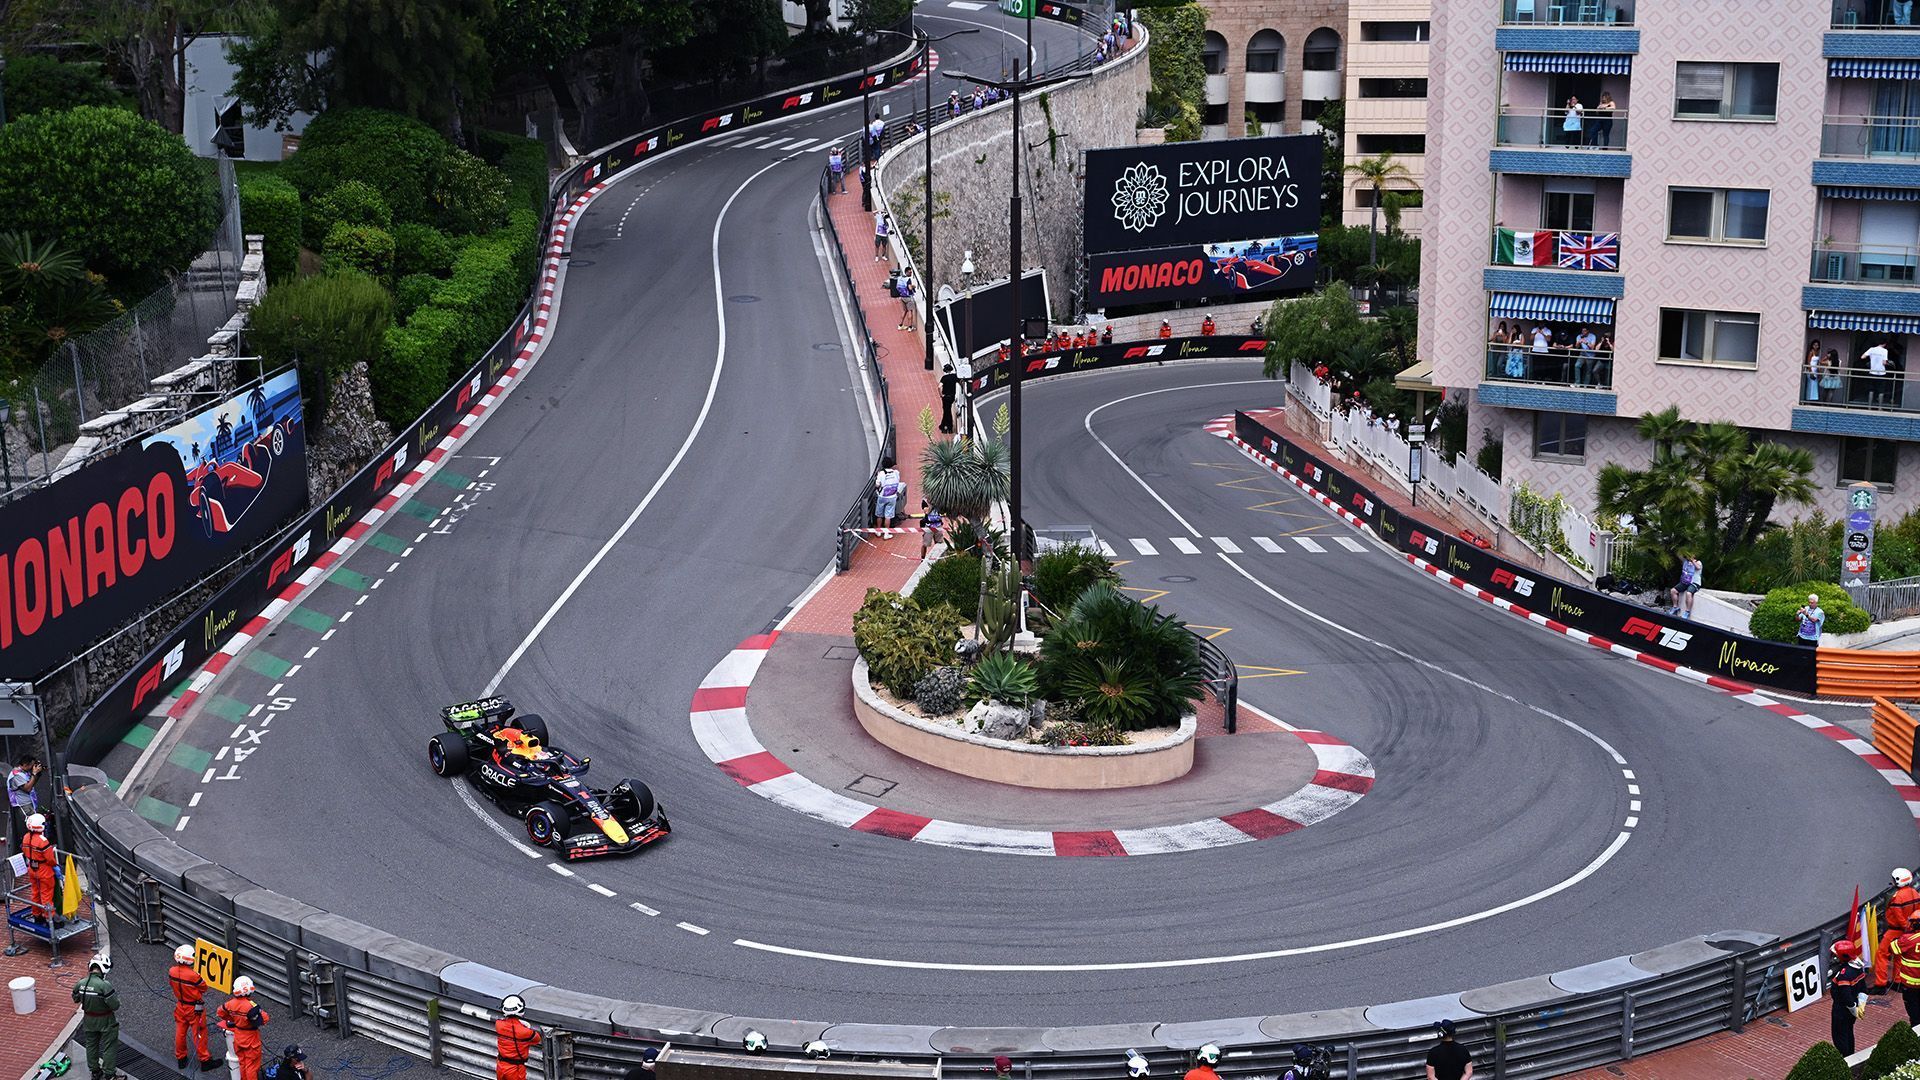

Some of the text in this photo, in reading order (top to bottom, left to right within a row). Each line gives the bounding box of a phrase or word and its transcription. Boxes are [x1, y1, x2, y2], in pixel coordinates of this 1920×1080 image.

[1179, 155, 1290, 187] EXPLORA
[1175, 184, 1299, 225] JOURNEYS
[1100, 259, 1204, 293] MONACO
[1551, 587, 1585, 619] Monaco
[205, 609, 238, 651] Monaco
[1718, 640, 1780, 677] Monaco
[215, 697, 297, 781] TAXIS
[482, 763, 518, 788] ORACLE
[198, 947, 228, 986] FCY
[1792, 964, 1817, 1002] SC
